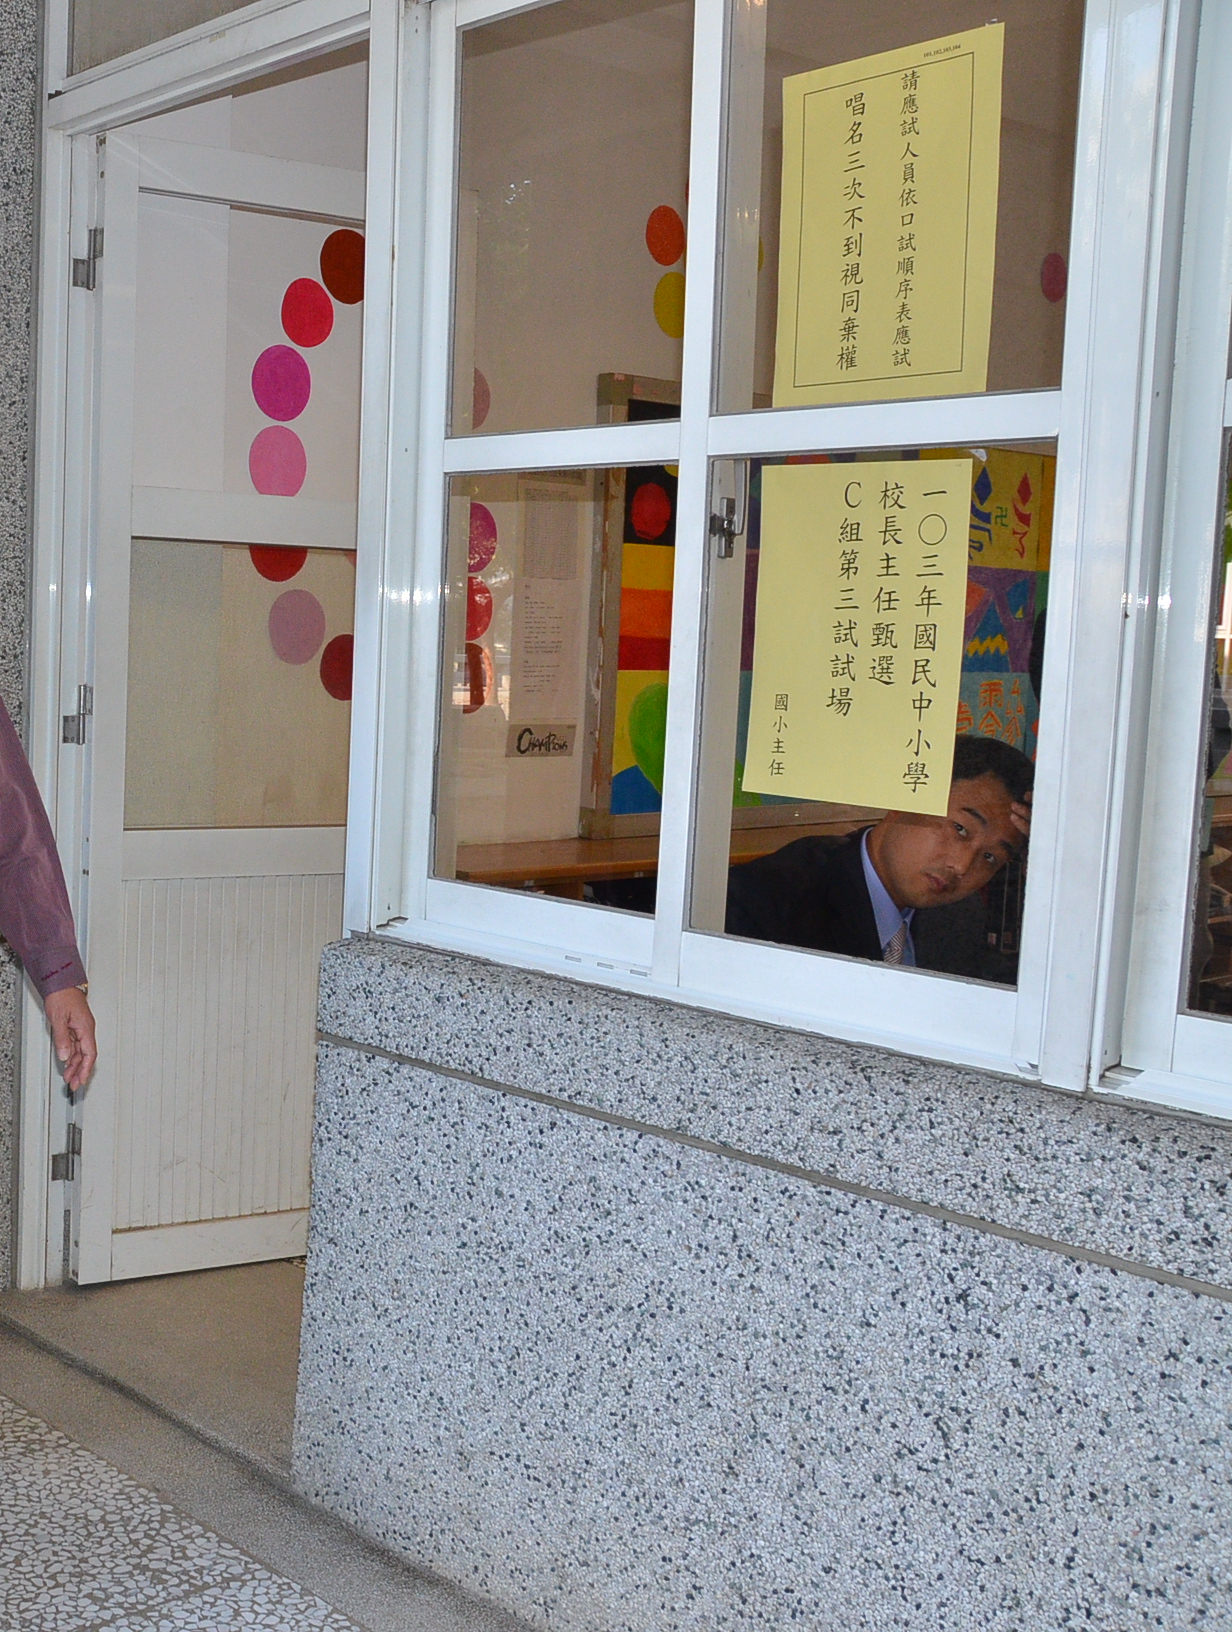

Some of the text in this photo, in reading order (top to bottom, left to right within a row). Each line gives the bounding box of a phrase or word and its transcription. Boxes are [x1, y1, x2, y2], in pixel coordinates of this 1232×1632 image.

[835, 92, 866, 371] 唱名三次不到視同棄權
[891, 70, 920, 368] 請應試人員依口試順序表應試
[825, 481, 864, 717] C組第三試試場
[868, 480, 907, 686] 校長主任甄選
[769, 693, 789, 776] 國小主任
